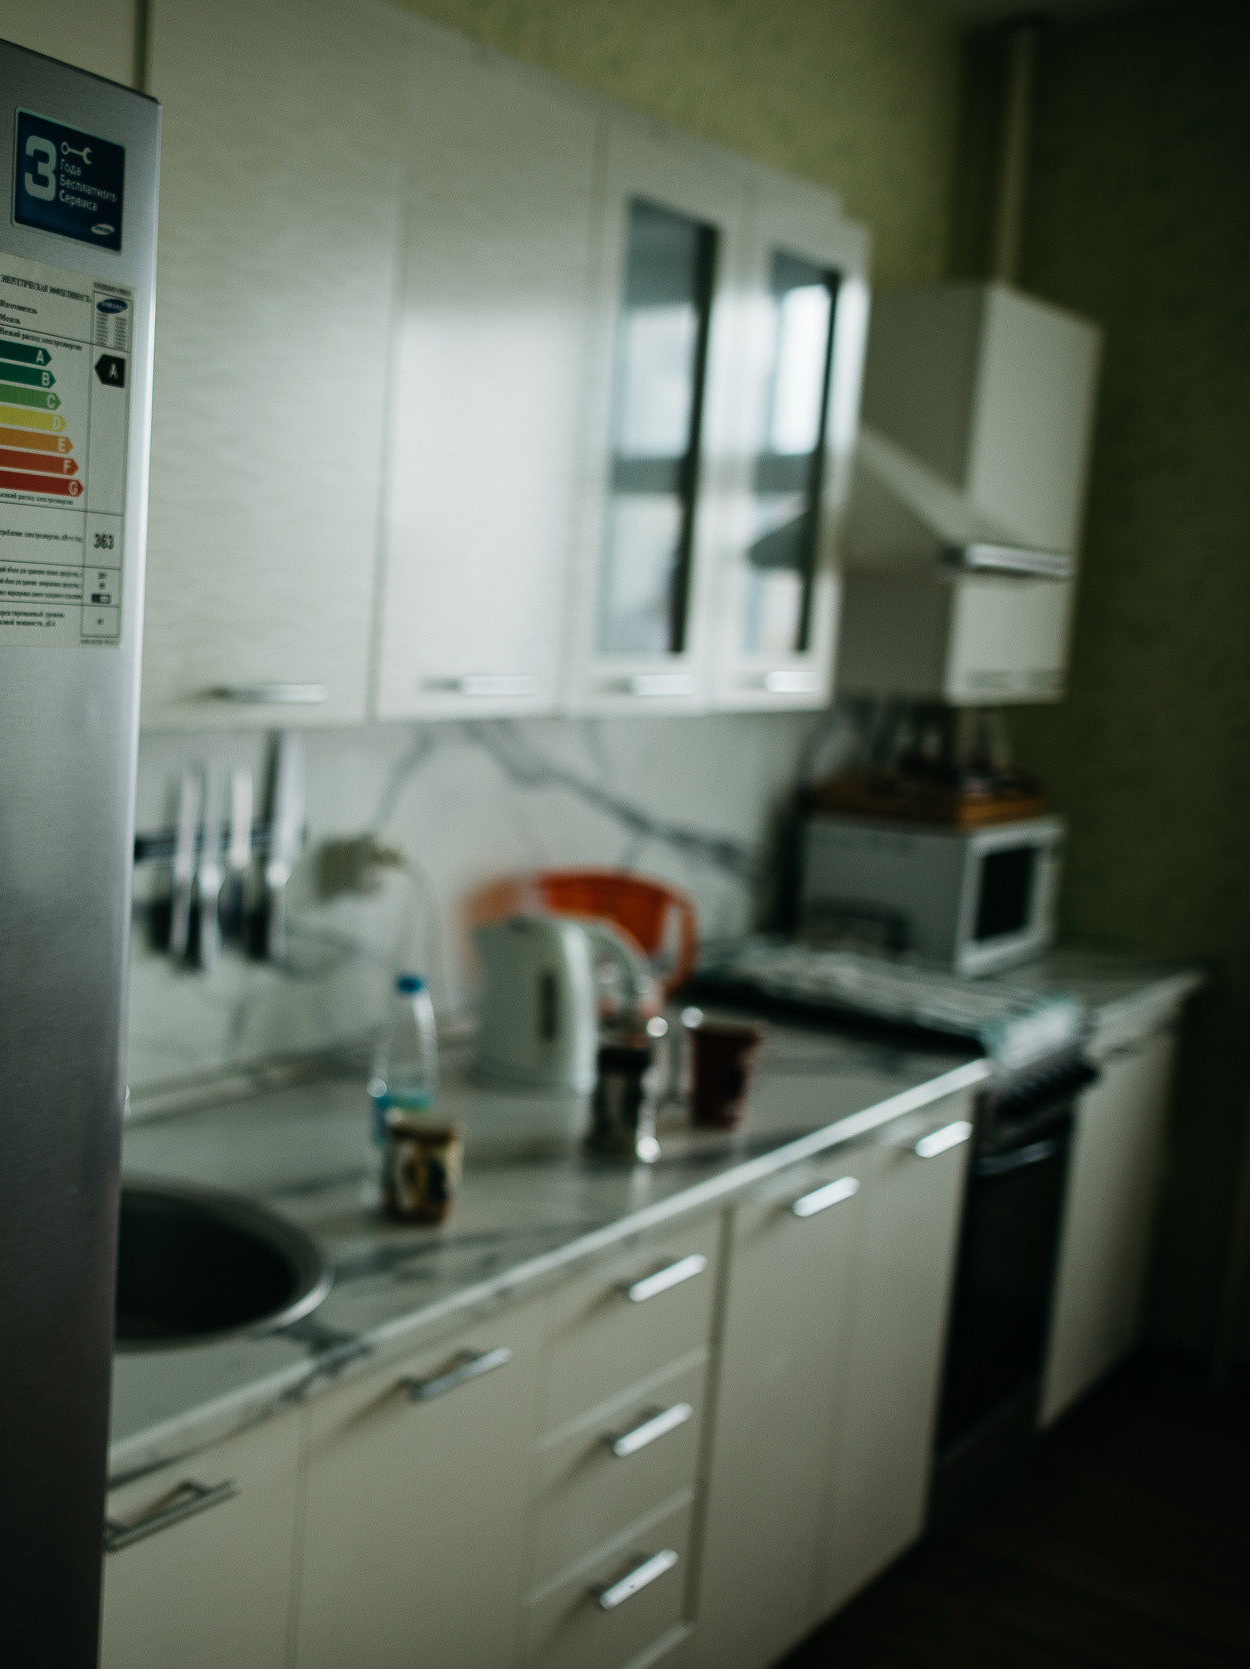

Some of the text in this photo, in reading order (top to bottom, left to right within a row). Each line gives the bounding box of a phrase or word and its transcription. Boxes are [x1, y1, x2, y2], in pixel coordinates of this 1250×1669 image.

[24, 135, 57, 201] 3
[60, 158, 82, 176] Года
[59, 174, 117, 203] Бесплатного
[59, 189, 98, 212] Сервиса
[36, 350, 44, 364] A
[109, 364, 117, 379] A
[42, 372, 50, 386] B
[47, 394, 56, 408] C
[53, 416, 61, 430] D
[58, 438, 66, 452] E
[63, 460, 71, 473] F
[69, 481, 78, 495] G
[93, 533, 114, 550] 363
